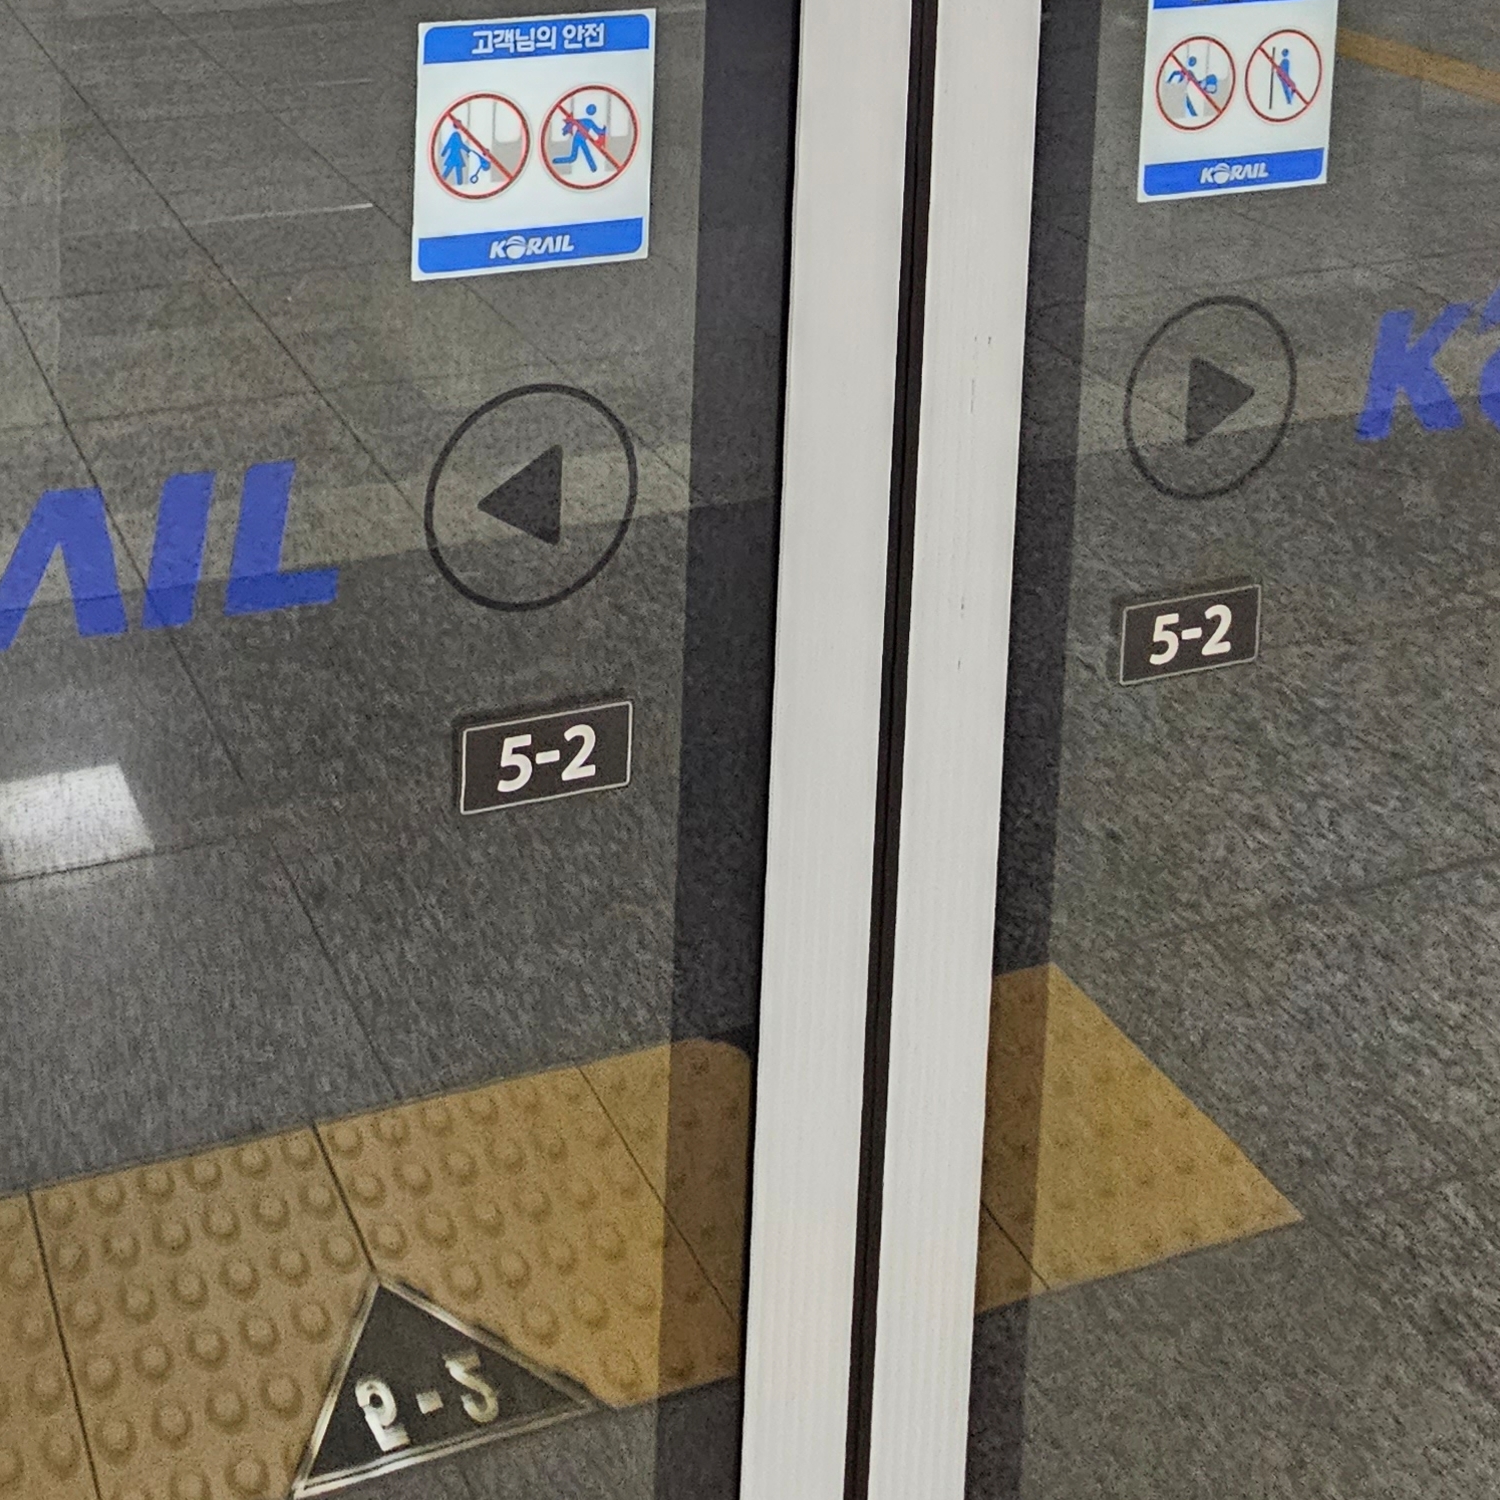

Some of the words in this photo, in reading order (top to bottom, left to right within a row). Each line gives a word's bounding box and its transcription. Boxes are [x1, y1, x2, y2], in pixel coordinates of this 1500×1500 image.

[472, 25, 557, 55] 고객님의
[562, 22, 606, 49] 안전
[1200, 162, 1269, 185] KORAIL
[489, 234, 575, 260] KORAIL
[1356, 279, 1500, 442] K
[1149, 603, 1232, 665] 5-2
[496, 723, 596, 793] 5-2
